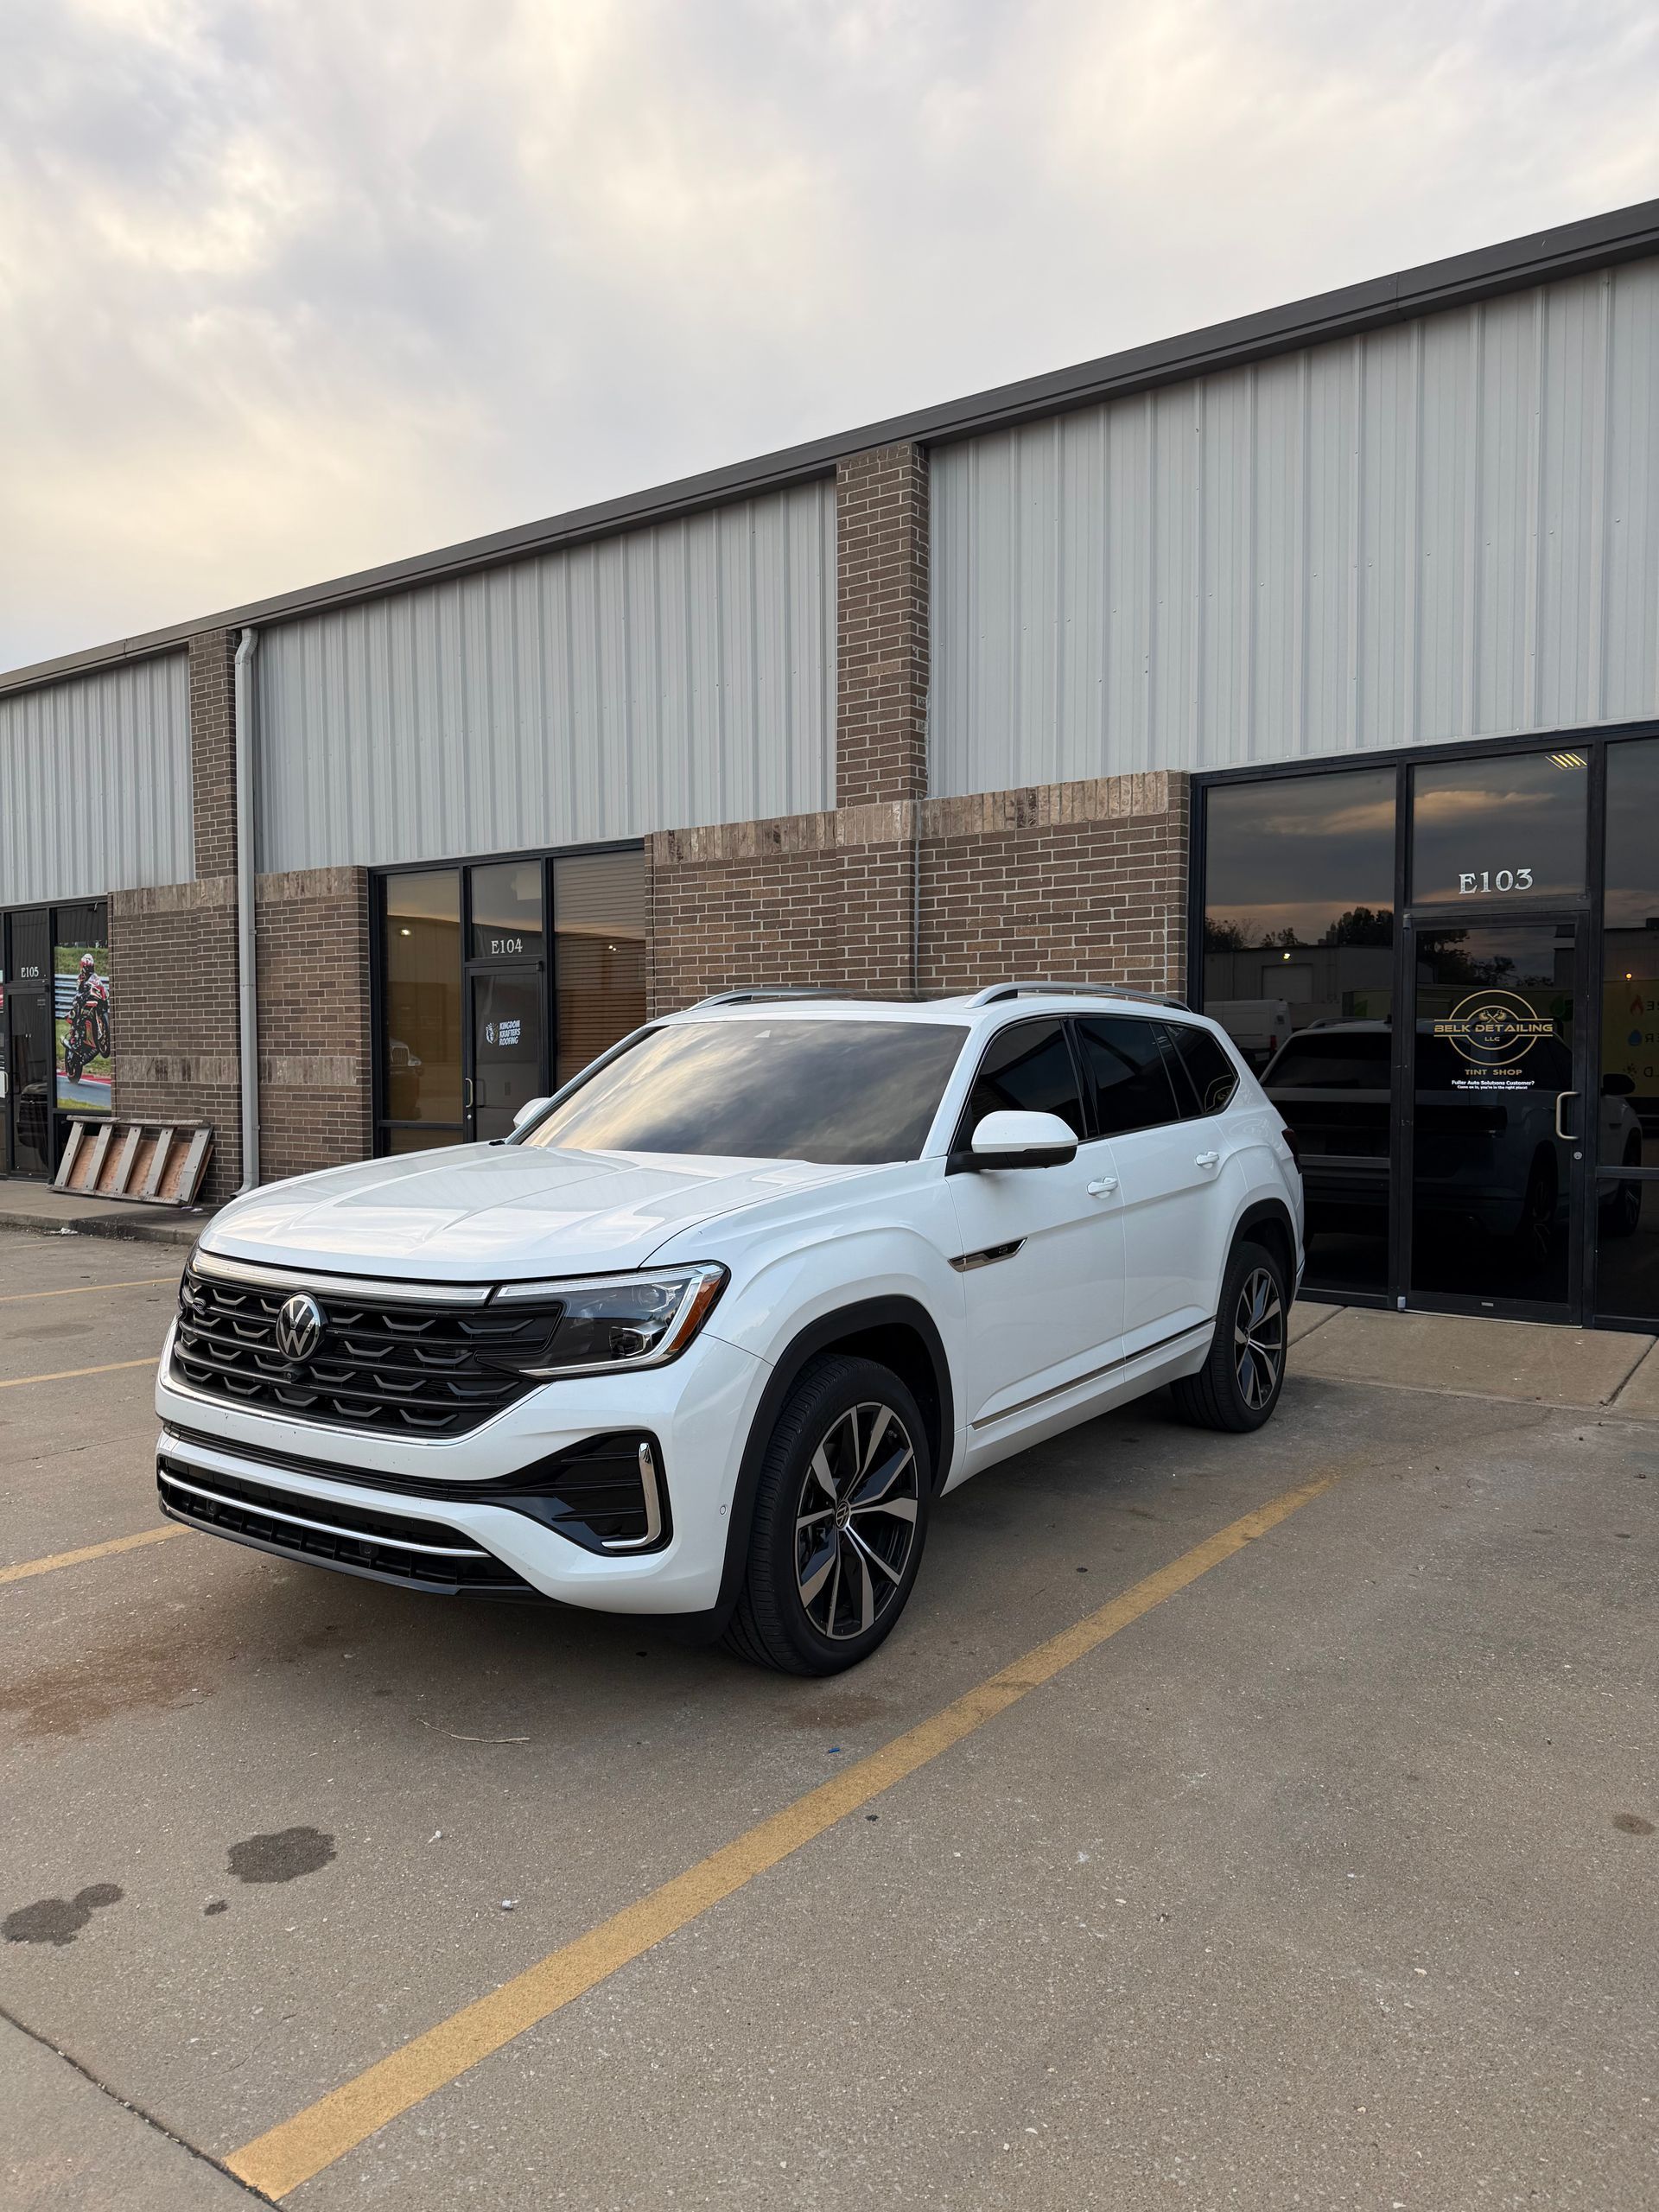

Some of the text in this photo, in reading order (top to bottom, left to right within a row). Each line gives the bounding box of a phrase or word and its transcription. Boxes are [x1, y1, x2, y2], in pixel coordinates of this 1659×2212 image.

[1459, 868, 1534, 894] E103
[491, 938, 523, 955] E104
[21, 966, 39, 978] E105
[499, 1020, 520, 1030] KINGDOM
[1434, 1024, 1554, 1033] BELK DETAILING
[499, 1028, 521, 1039] KRAFTERS
[499, 1036, 518, 1046] ROOFING
